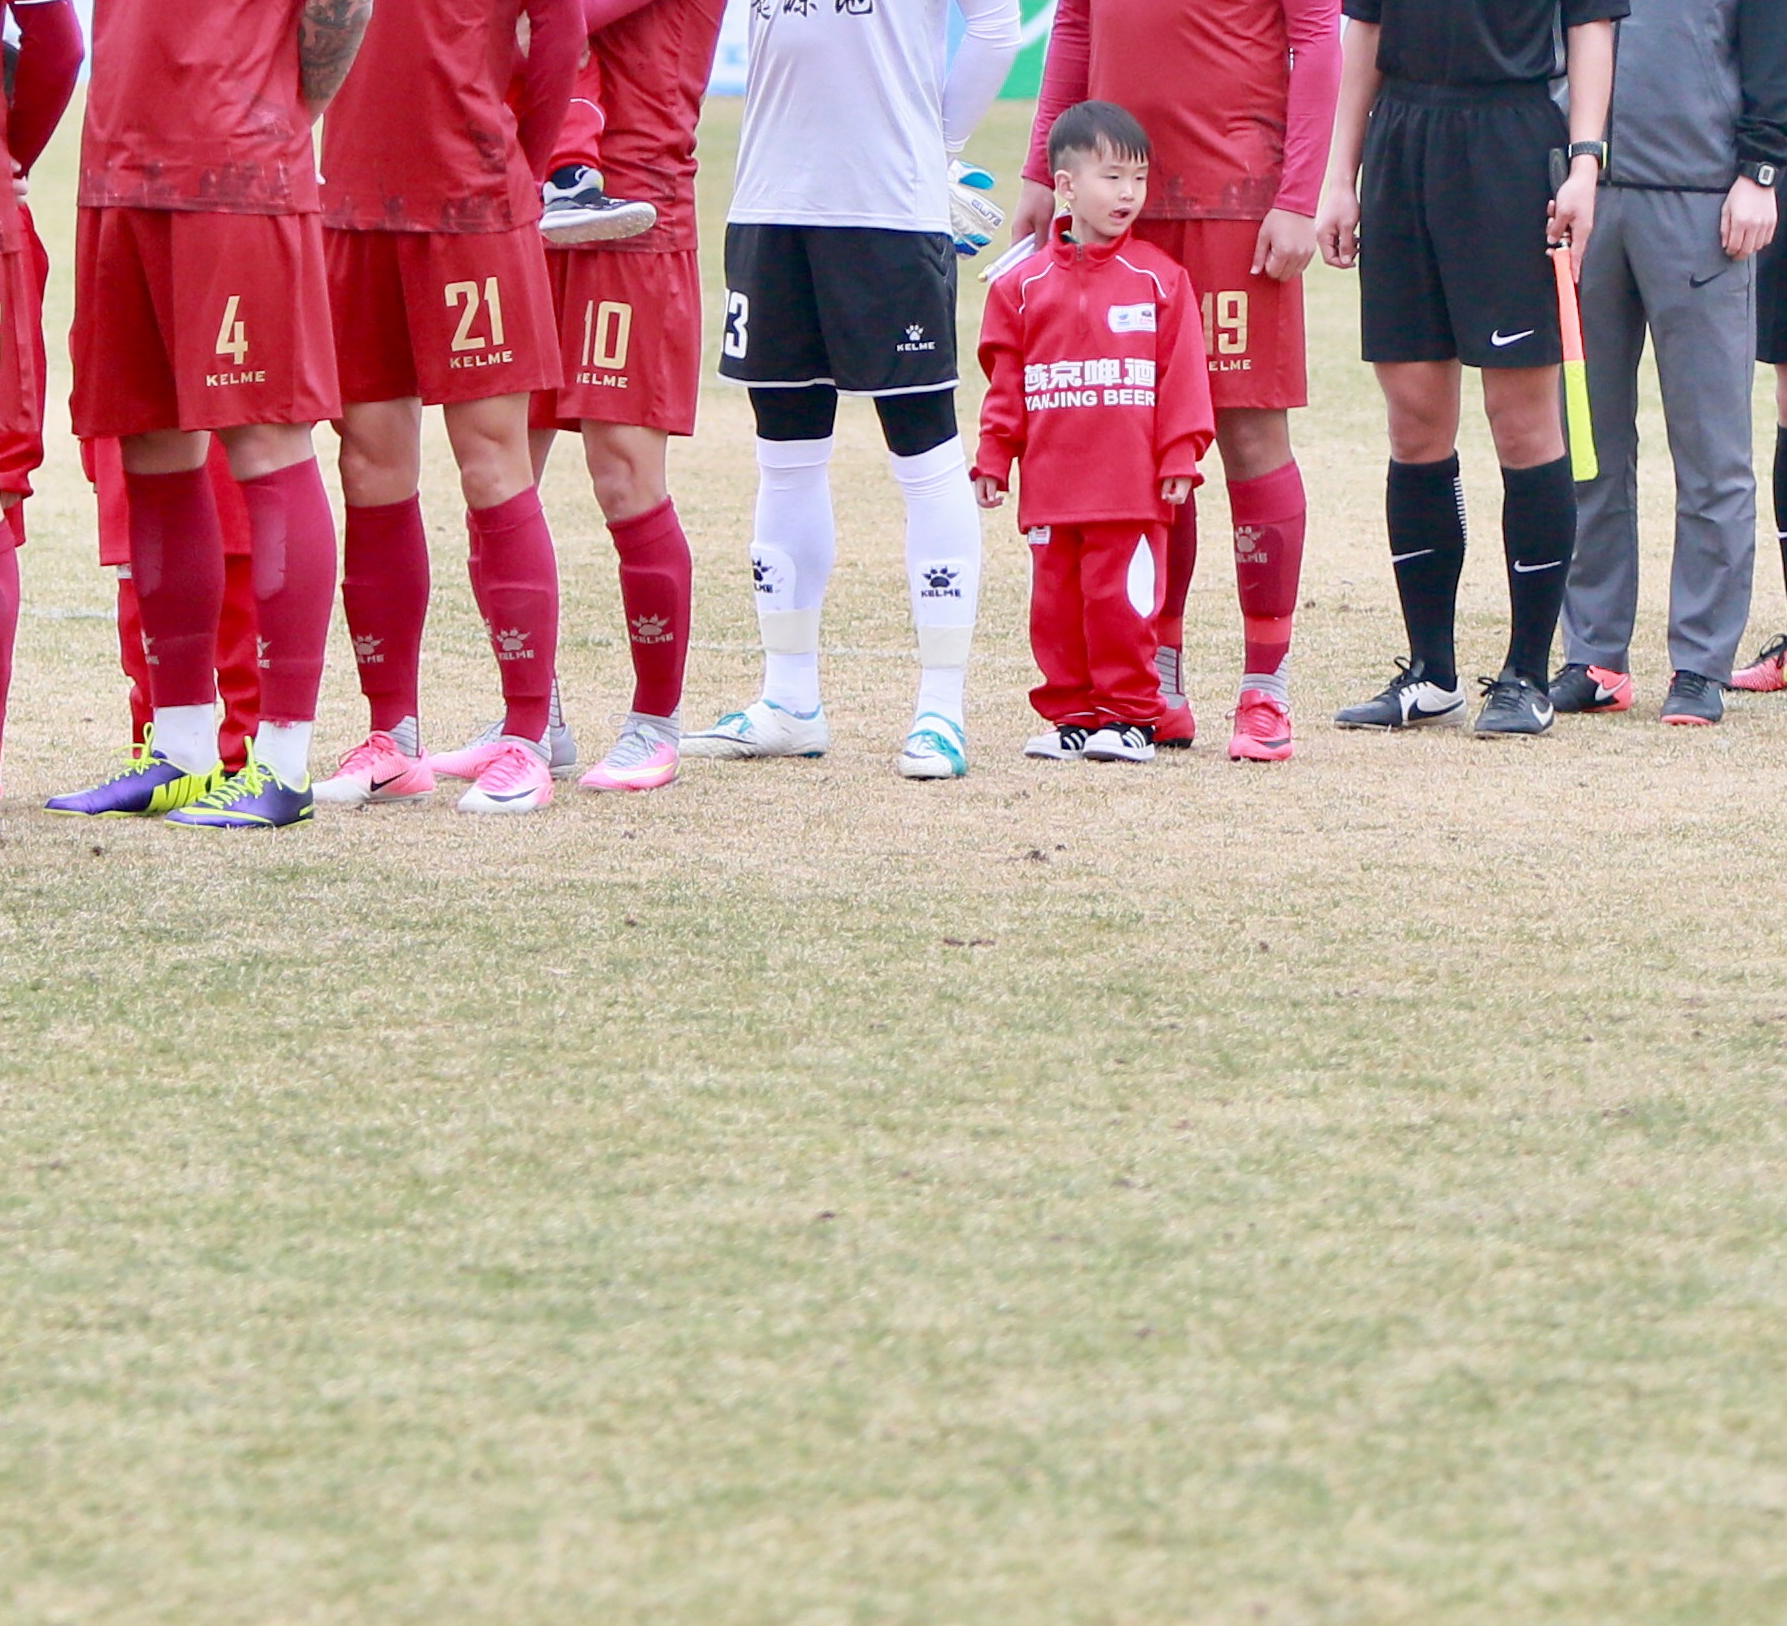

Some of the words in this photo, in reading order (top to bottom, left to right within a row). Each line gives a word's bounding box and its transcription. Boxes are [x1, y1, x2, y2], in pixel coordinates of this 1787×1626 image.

[444, 276, 505, 353] 21
[1200, 290, 1249, 356] 19
[215, 294, 249, 365] 4
[581, 299, 633, 370] 10
[896, 341, 936, 352] KELME
[449, 350, 514, 369] KELME
[1208, 359, 1252, 372] ELME
[206, 370, 267, 388] KELME
[1024, 390, 1099, 412] YANJING
[1103, 388, 1156, 407] BEER
[920, 587, 962, 598] KELME
